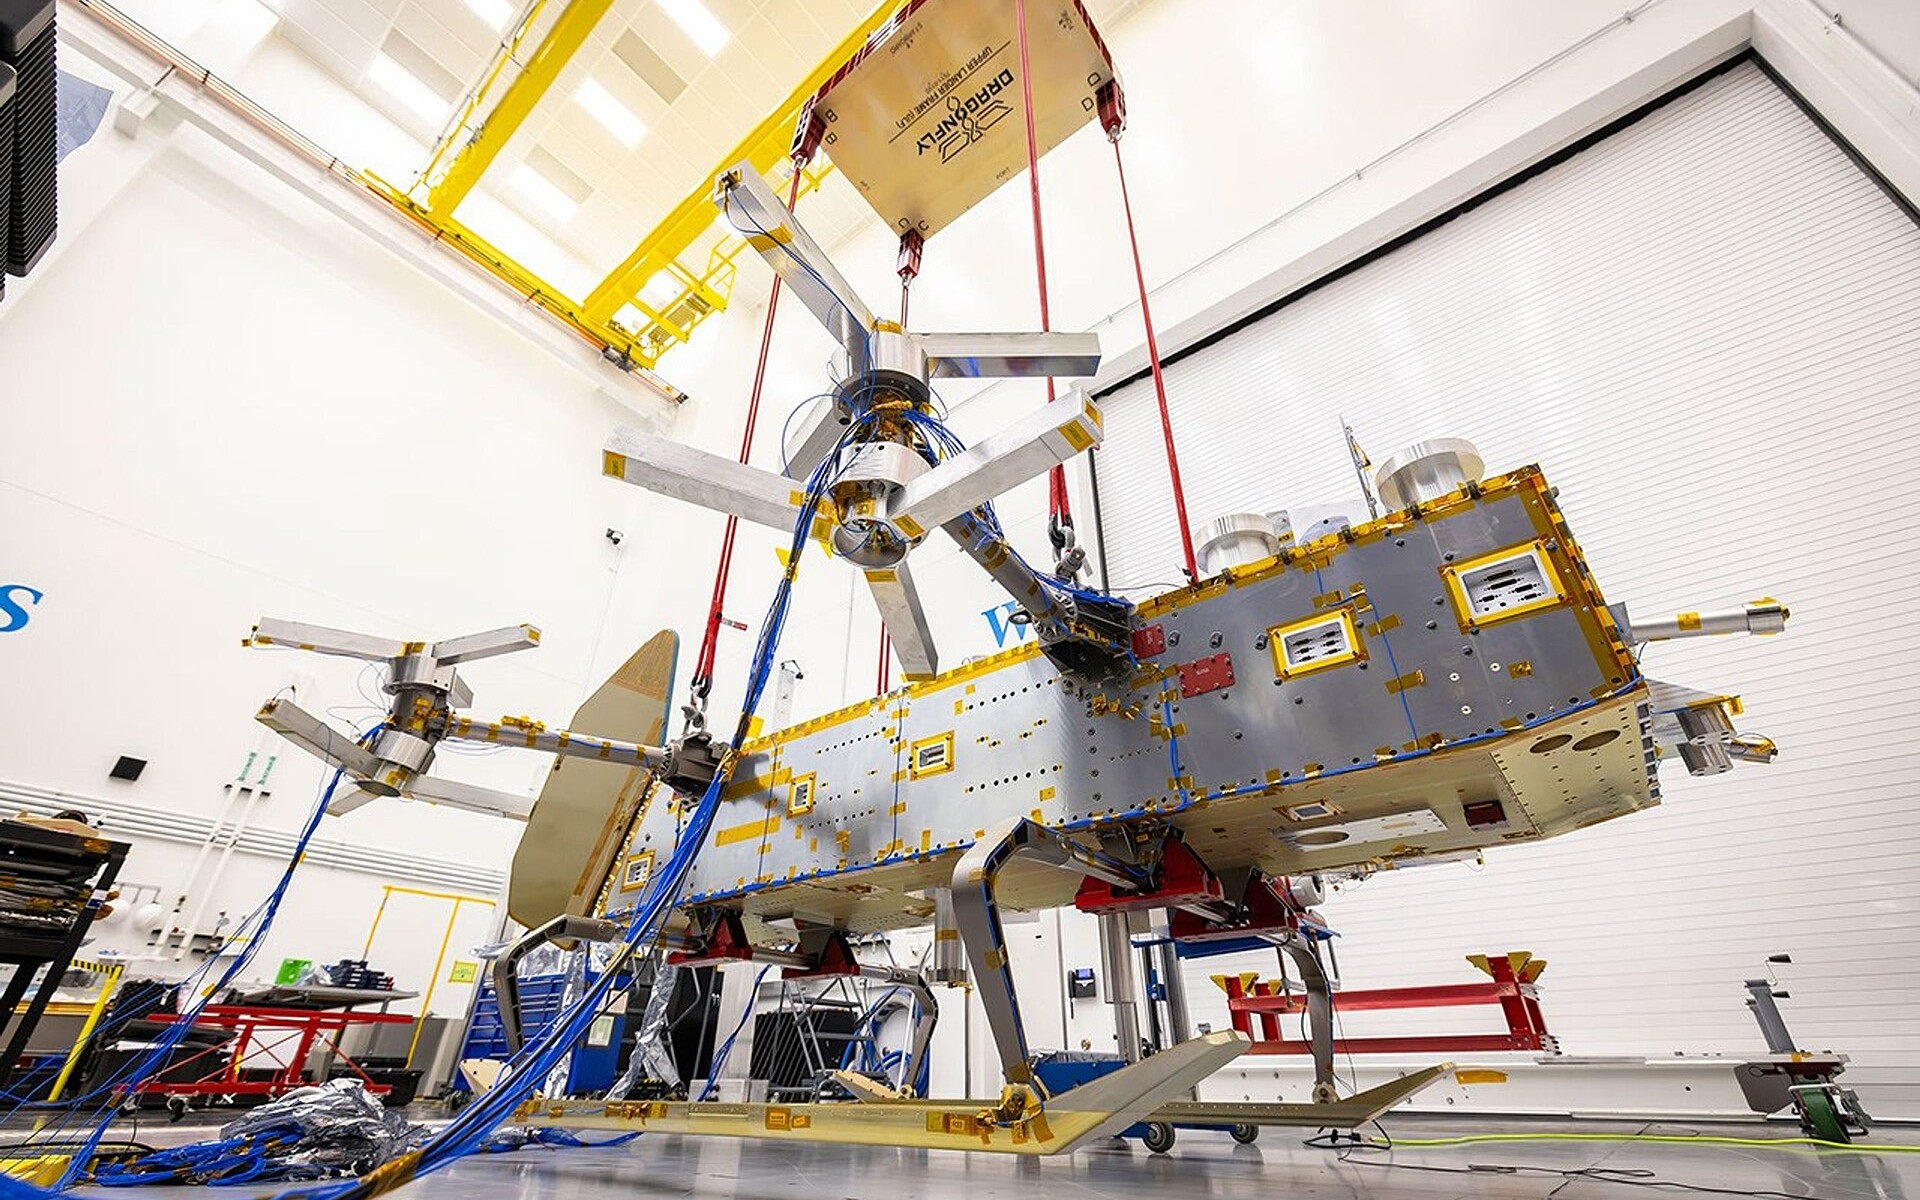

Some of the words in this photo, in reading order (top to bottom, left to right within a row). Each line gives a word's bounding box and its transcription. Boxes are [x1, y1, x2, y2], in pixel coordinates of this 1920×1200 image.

[965, 46, 993, 71] UPPER
[939, 67, 968, 94] LANDER
[1087, 72, 1101, 87] D
[914, 93, 940, 115] FRAME
[916, 68, 1014, 155] DRAGONFLY
[1081, 97, 1094, 111] D
[825, 108, 838, 123] B
[825, 132, 838, 145] B
[917, 220, 930, 232] C
